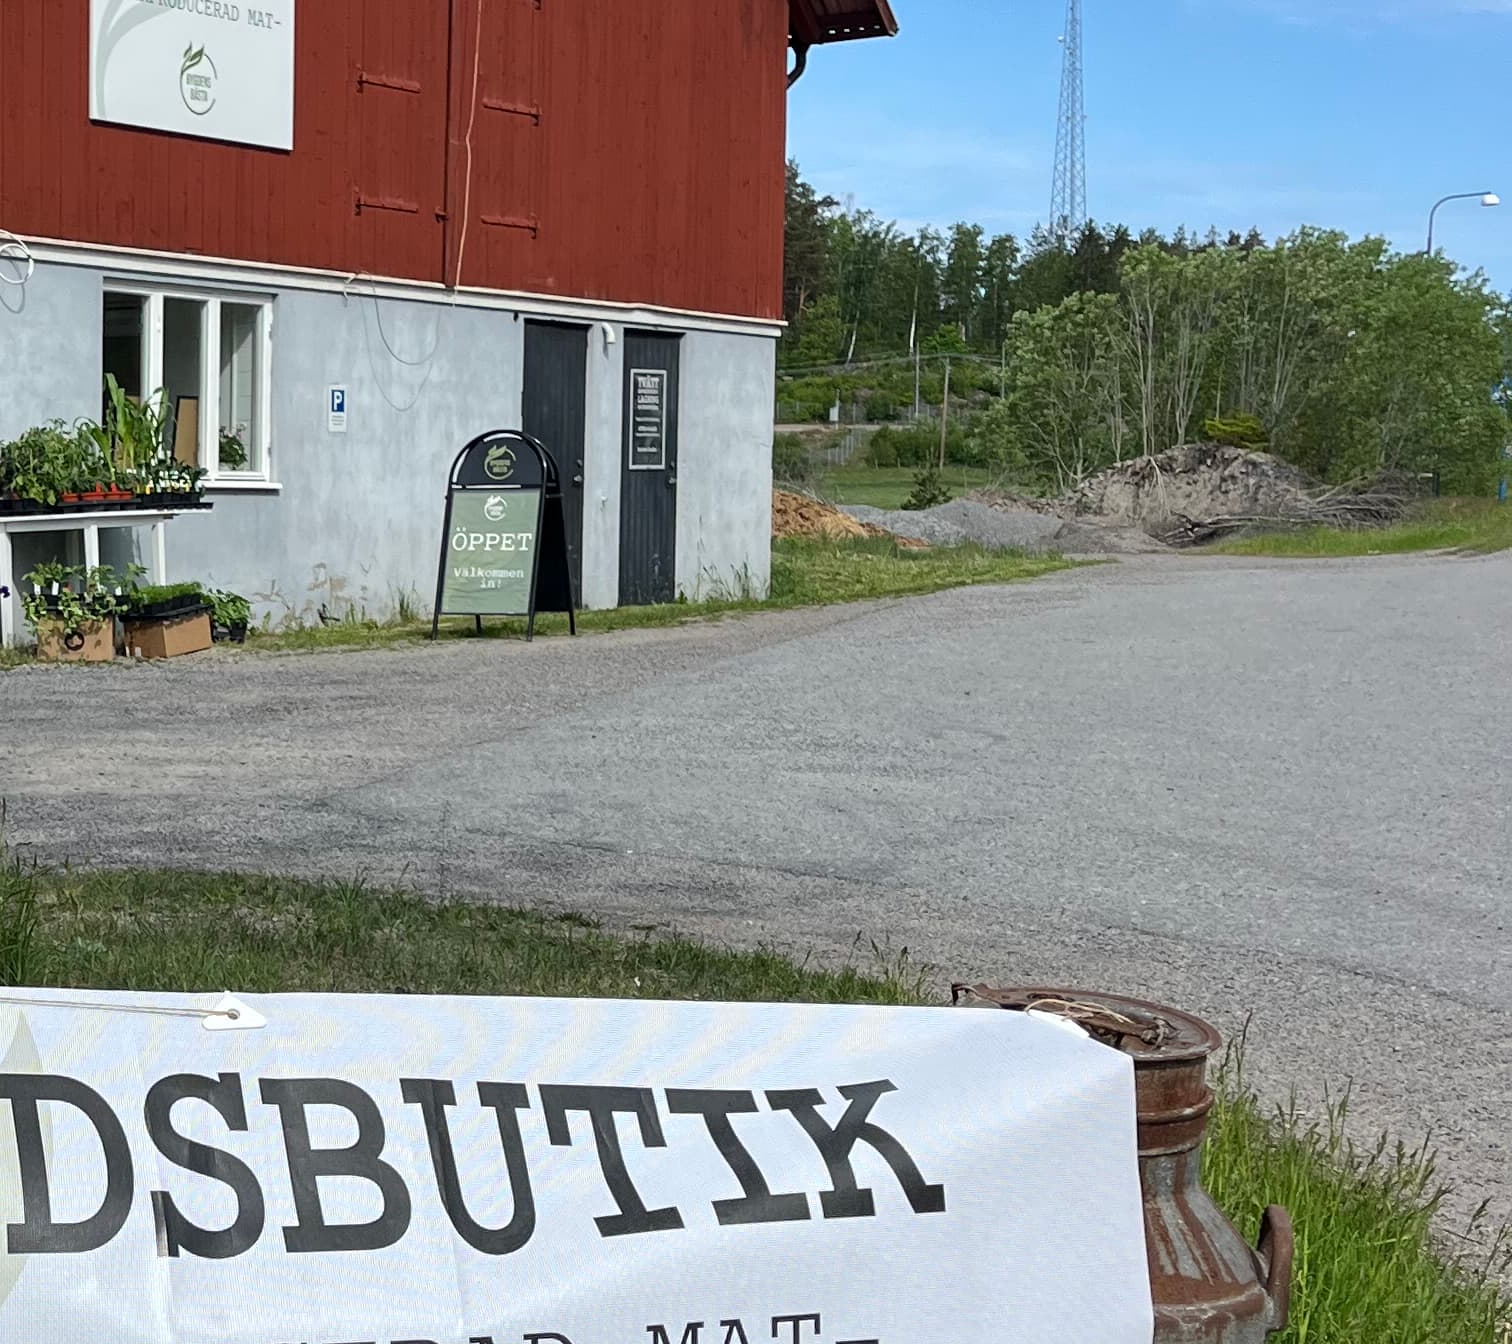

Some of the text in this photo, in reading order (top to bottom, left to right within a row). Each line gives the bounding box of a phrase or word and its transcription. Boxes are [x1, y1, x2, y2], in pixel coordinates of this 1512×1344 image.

[452, 527, 532, 551] ÖPPET
[454, 567, 525, 579] Välkommen
[480, 578, 502, 589] in!
